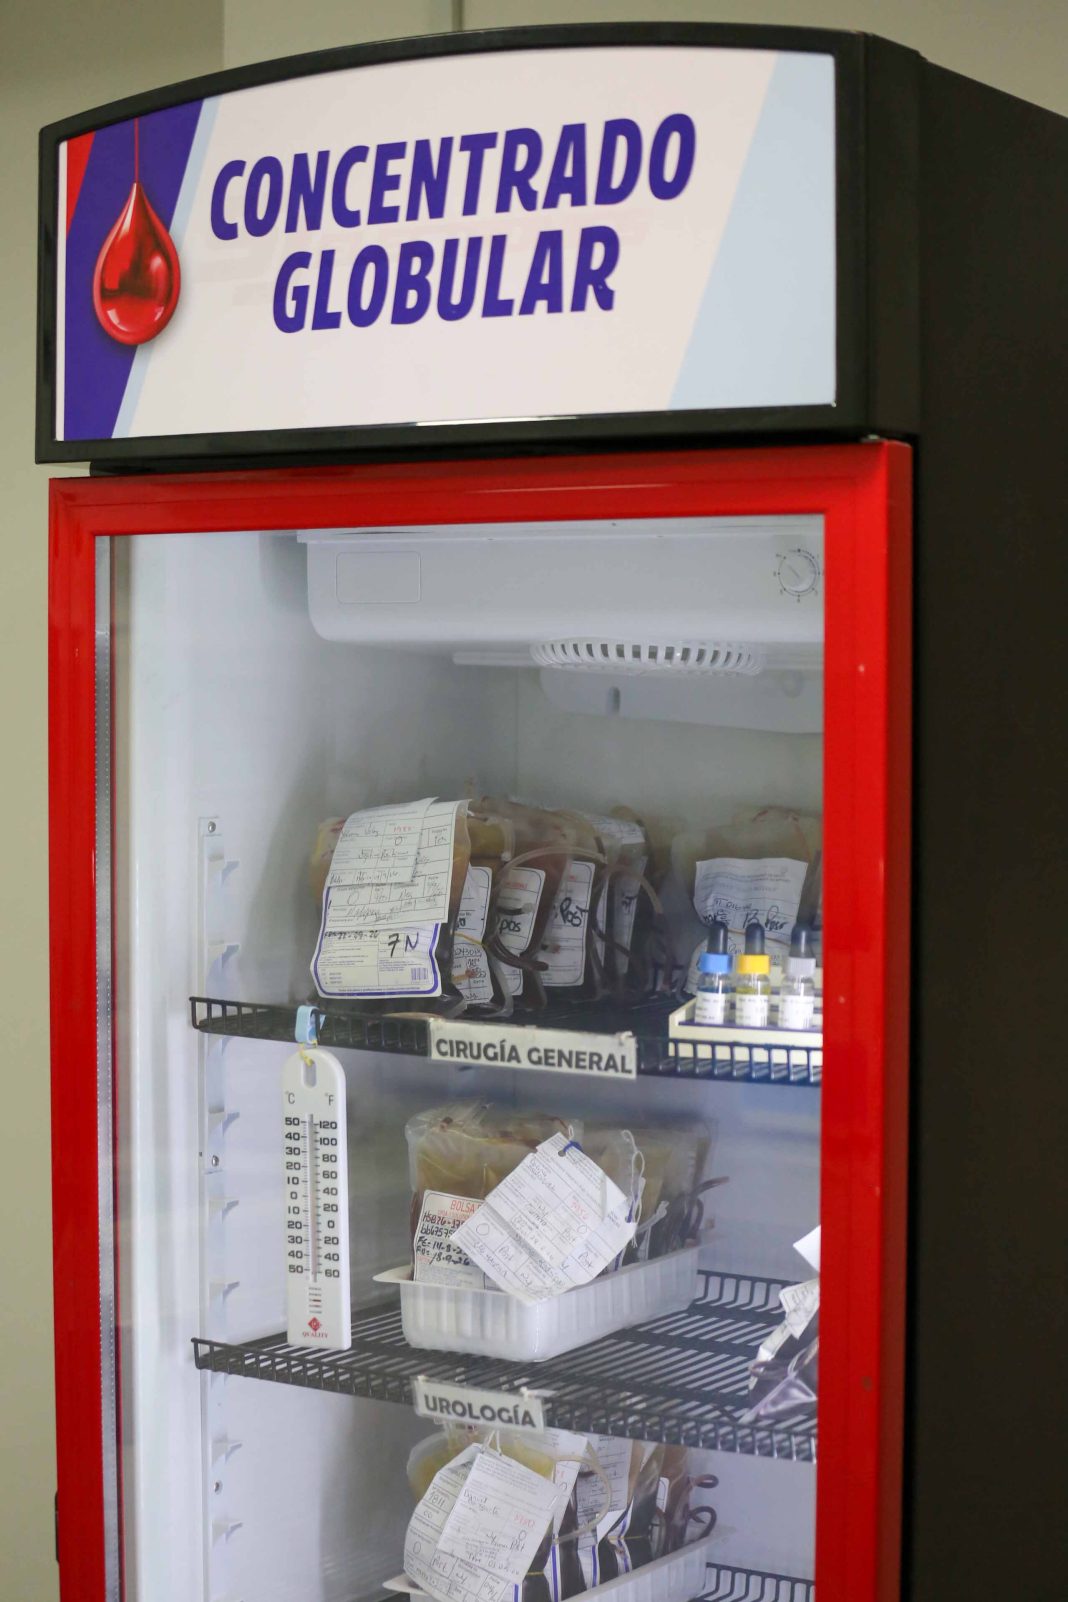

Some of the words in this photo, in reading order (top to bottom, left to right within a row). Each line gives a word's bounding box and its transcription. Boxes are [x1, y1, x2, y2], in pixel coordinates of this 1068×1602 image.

[211, 113, 697, 241] CONCENTRADO
[272, 226, 620, 333] GLOBULAR
[435, 1039, 522, 1064] CIRUGÍA
[527, 1047, 633, 1074] GENERAL
[285, 1117, 300, 1126] 50
[319, 1120, 338, 1130] 120
[285, 1132, 300, 1141] 40
[319, 1137, 338, 1146] 100
[285, 1146, 301, 1156] 30
[322, 1154, 338, 1163] 80
[286, 1161, 301, 1171] 20
[322, 1170, 338, 1180] 60
[287, 1176, 300, 1185] 10
[290, 1191, 298, 1200] 0
[323, 1187, 338, 1196] 40
[288, 1206, 300, 1215] 10
[323, 1204, 339, 1213] 20
[451, 1200, 475, 1213] BOLSA
[287, 1221, 302, 1229] 20
[327, 1220, 335, 1229] 0
[287, 1235, 303, 1244] 30
[324, 1236, 339, 1245] 20
[288, 1250, 303, 1259] 40
[324, 1253, 340, 1262] 40
[288, 1265, 304, 1274] 50
[324, 1269, 340, 1278] 60
[424, 1393, 537, 1428] UROLOGÍA
